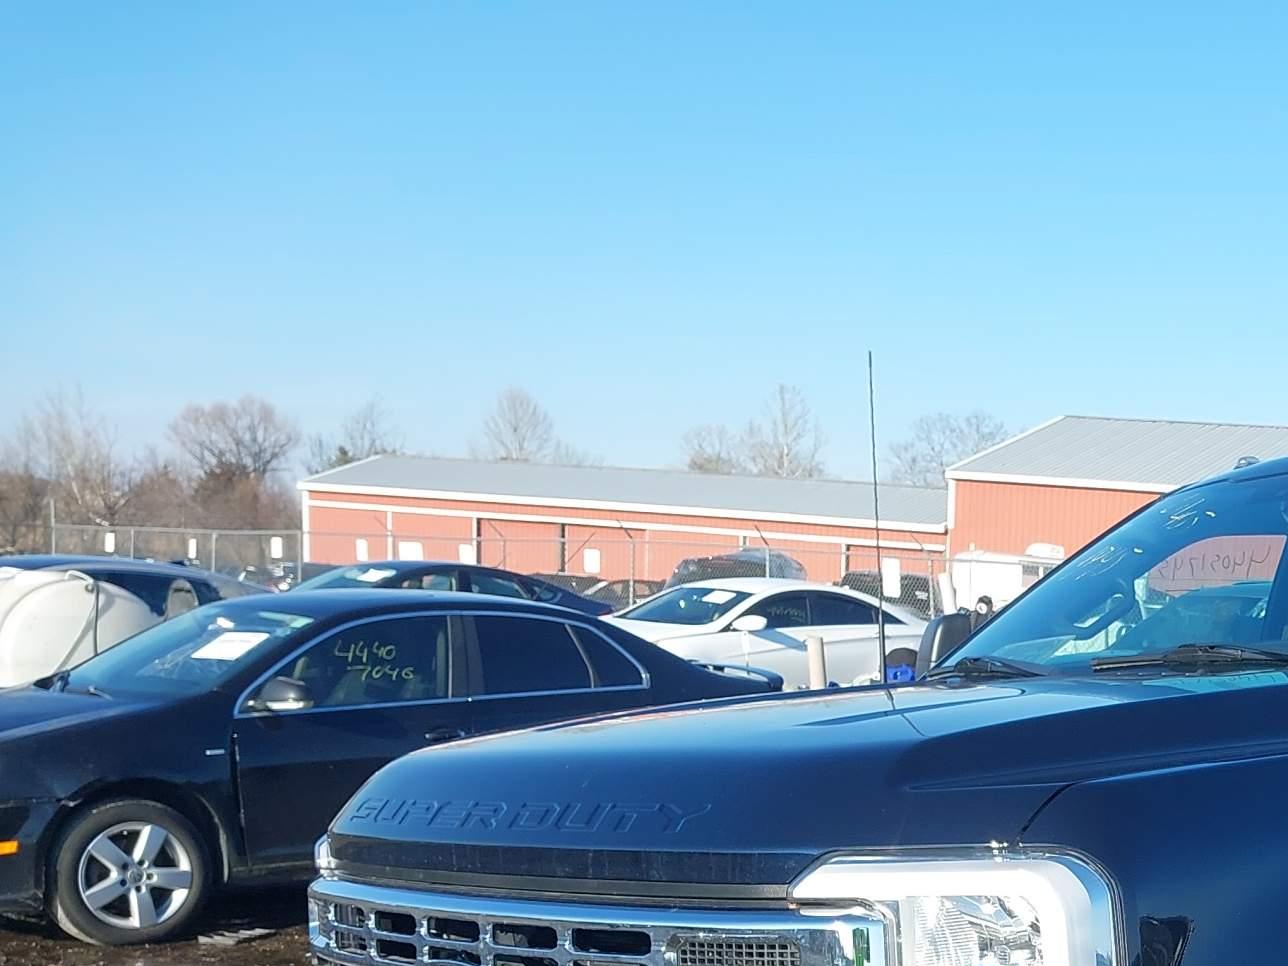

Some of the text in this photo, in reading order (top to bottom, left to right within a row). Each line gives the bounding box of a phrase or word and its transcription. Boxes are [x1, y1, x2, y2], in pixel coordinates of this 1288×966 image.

[334, 640, 396, 663] 4440
[347, 664, 415, 681] 7046
[350, 797, 712, 833] SUPER DUTY
